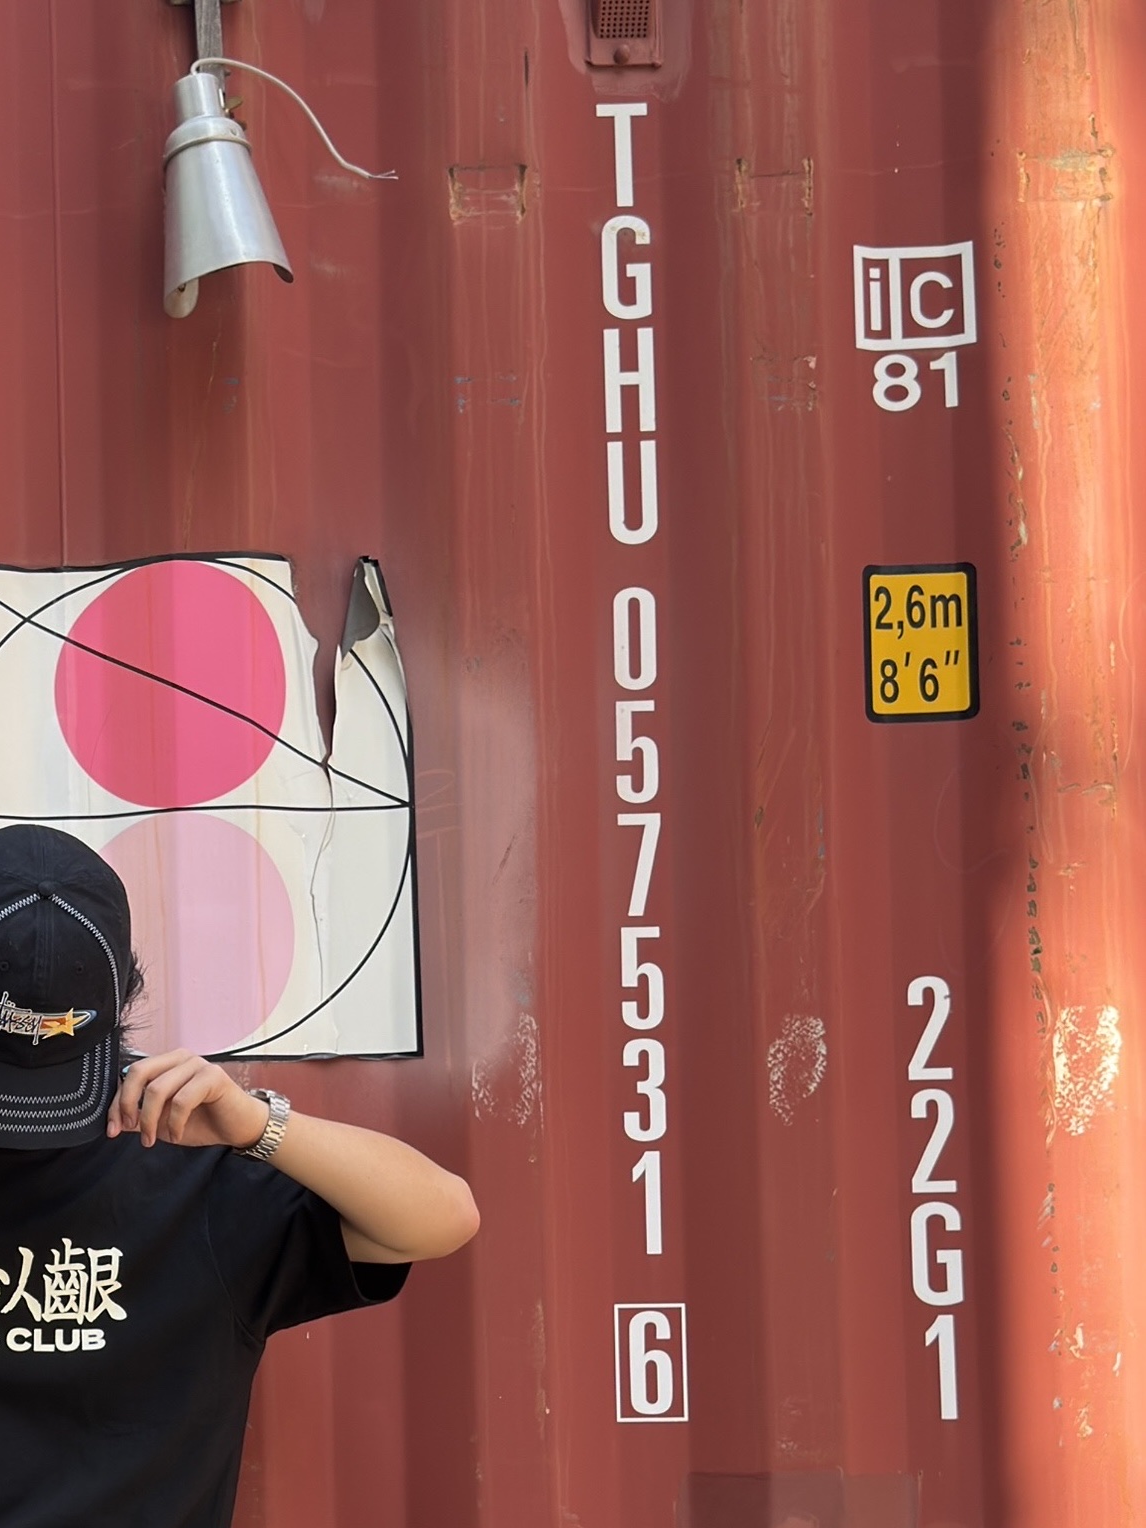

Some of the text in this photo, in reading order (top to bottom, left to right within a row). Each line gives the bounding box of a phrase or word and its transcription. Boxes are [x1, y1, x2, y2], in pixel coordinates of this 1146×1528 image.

[872, 351, 959, 412] 81
[874, 584, 963, 640] 2,6m
[596, 103, 674, 1415] TGHU 057531 6
[907, 976, 965, 1420] 22G1
[6, 1327, 107, 1353] CLUB
